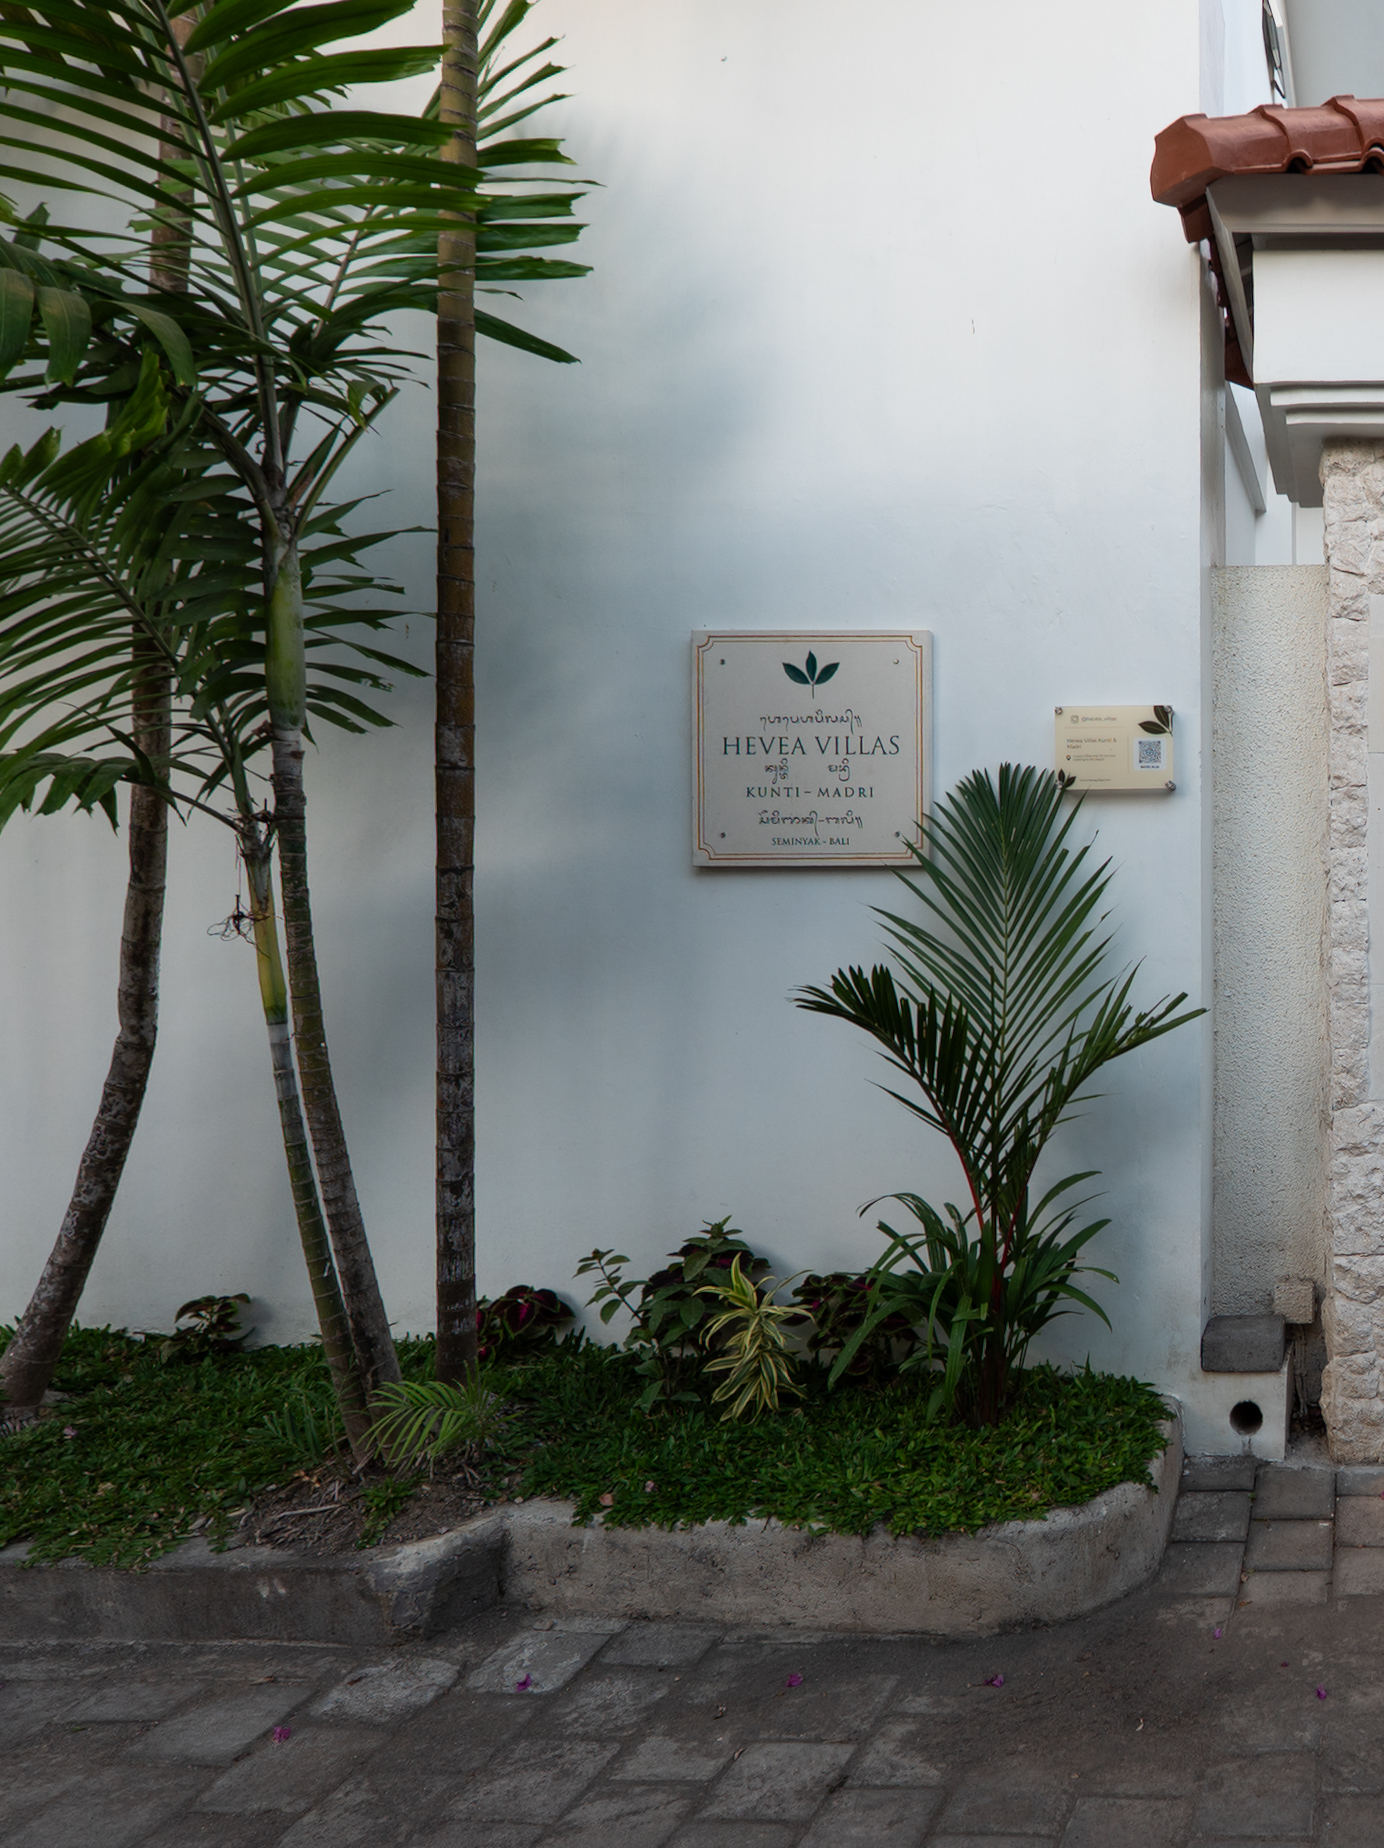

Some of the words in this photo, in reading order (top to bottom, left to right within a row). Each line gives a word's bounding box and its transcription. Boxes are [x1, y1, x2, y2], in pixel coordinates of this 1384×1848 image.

[722, 736, 807, 756] HEVEA
[815, 735, 901, 756] VILLAS
[746, 786, 800, 799] KUNTI
[817, 786, 874, 799] MADRI
[772, 837, 821, 846] SEMINYAK
[829, 837, 850, 846] BALI
